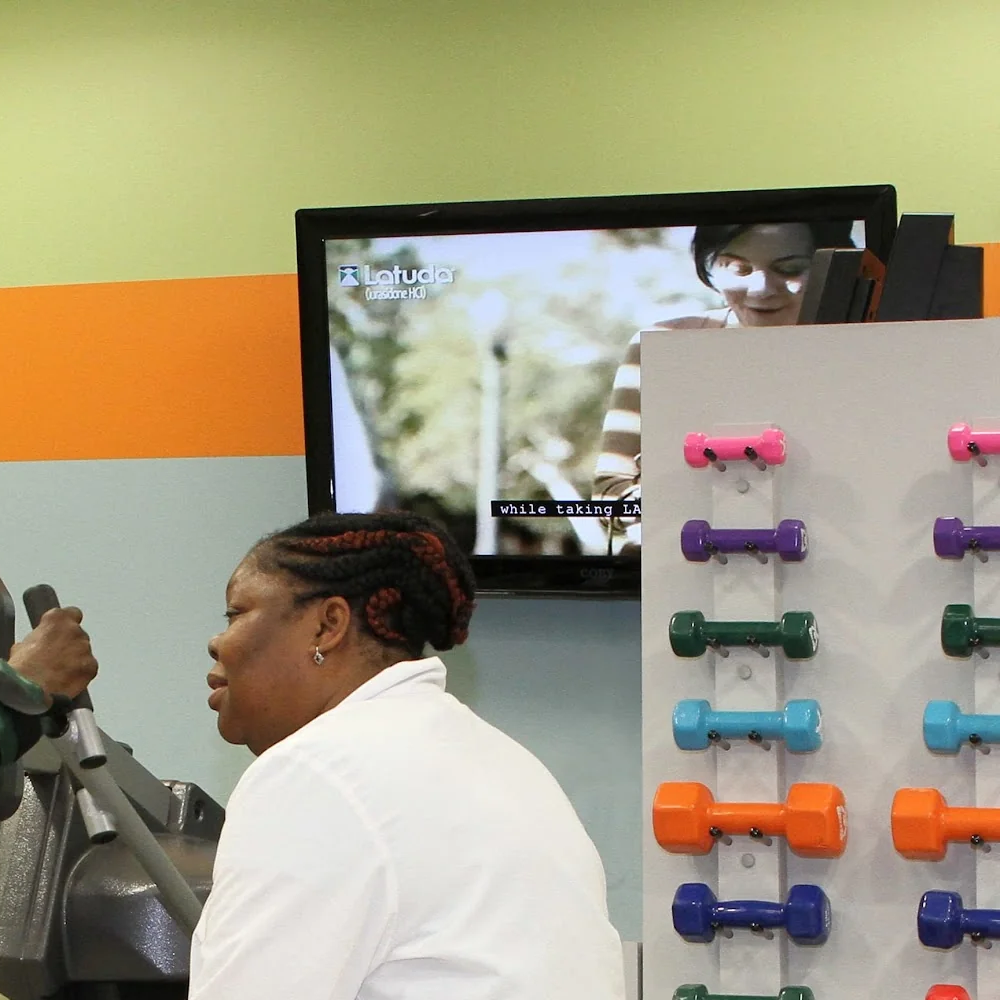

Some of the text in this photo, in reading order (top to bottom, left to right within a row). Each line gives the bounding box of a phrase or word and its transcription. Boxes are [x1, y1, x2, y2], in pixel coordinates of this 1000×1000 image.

[364, 264, 454, 285] Latuda
[500, 503, 547, 514] while
[556, 503, 613, 517] taking
